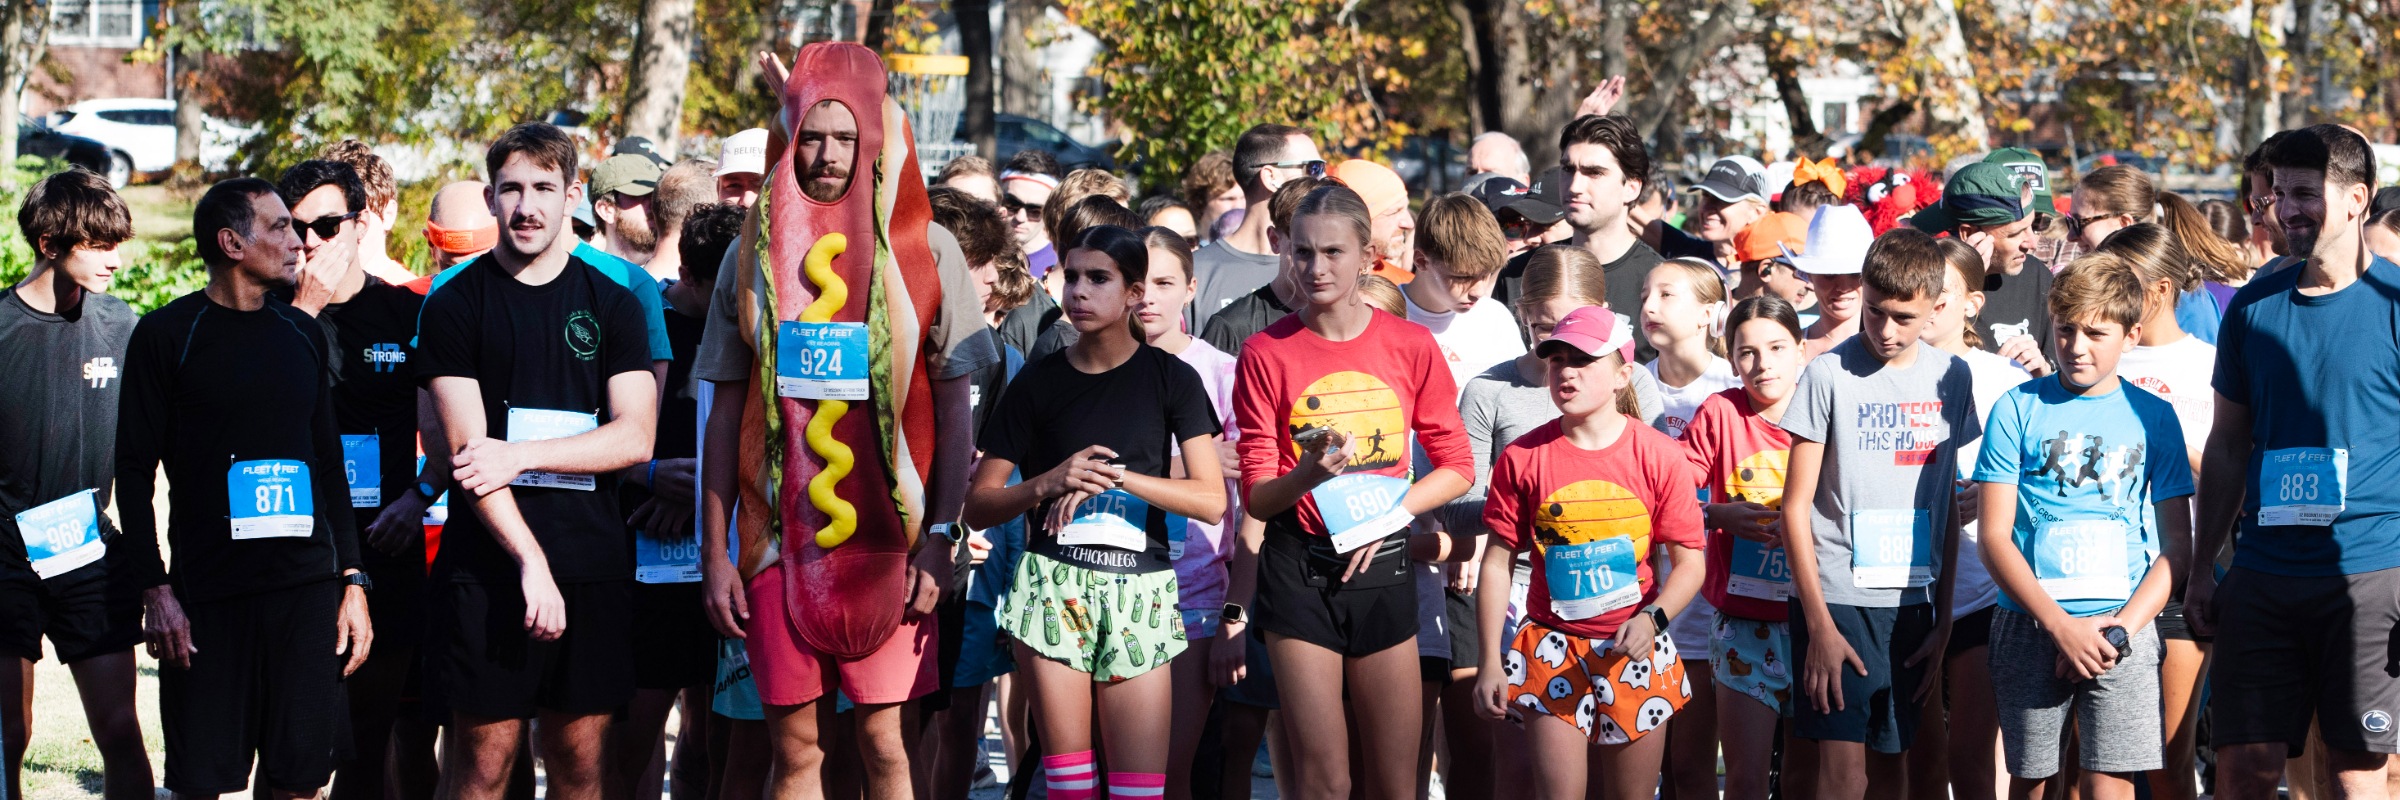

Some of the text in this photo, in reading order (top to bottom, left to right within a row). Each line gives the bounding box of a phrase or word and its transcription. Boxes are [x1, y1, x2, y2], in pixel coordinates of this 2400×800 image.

[734, 146, 767, 156] BELIEV
[792, 328, 853, 337] FLEET FEET
[363, 348, 406, 363] STRONG
[801, 348, 843, 376] 924
[2130, 376, 2163, 392] ILSON
[1665, 417, 1687, 431] LSON
[1857, 401, 1944, 428] PROTECT
[1857, 431, 1891, 451] THIS
[2274, 453, 2332, 464] FLEET FEET
[243, 465, 299, 475] FLEET FEET
[2279, 473, 2319, 501] 883
[255, 485, 295, 514] 871
[1084, 493, 1127, 522] 975
[1345, 485, 1391, 522] 890
[2109, 506, 2126, 521] 2023
[46, 518, 84, 552] 968
[1072, 546, 1137, 568] CHICKNLEGS
[1555, 542, 1618, 560] FLEET FEET
[1879, 534, 1912, 564] 889
[1568, 564, 1614, 597] 710
